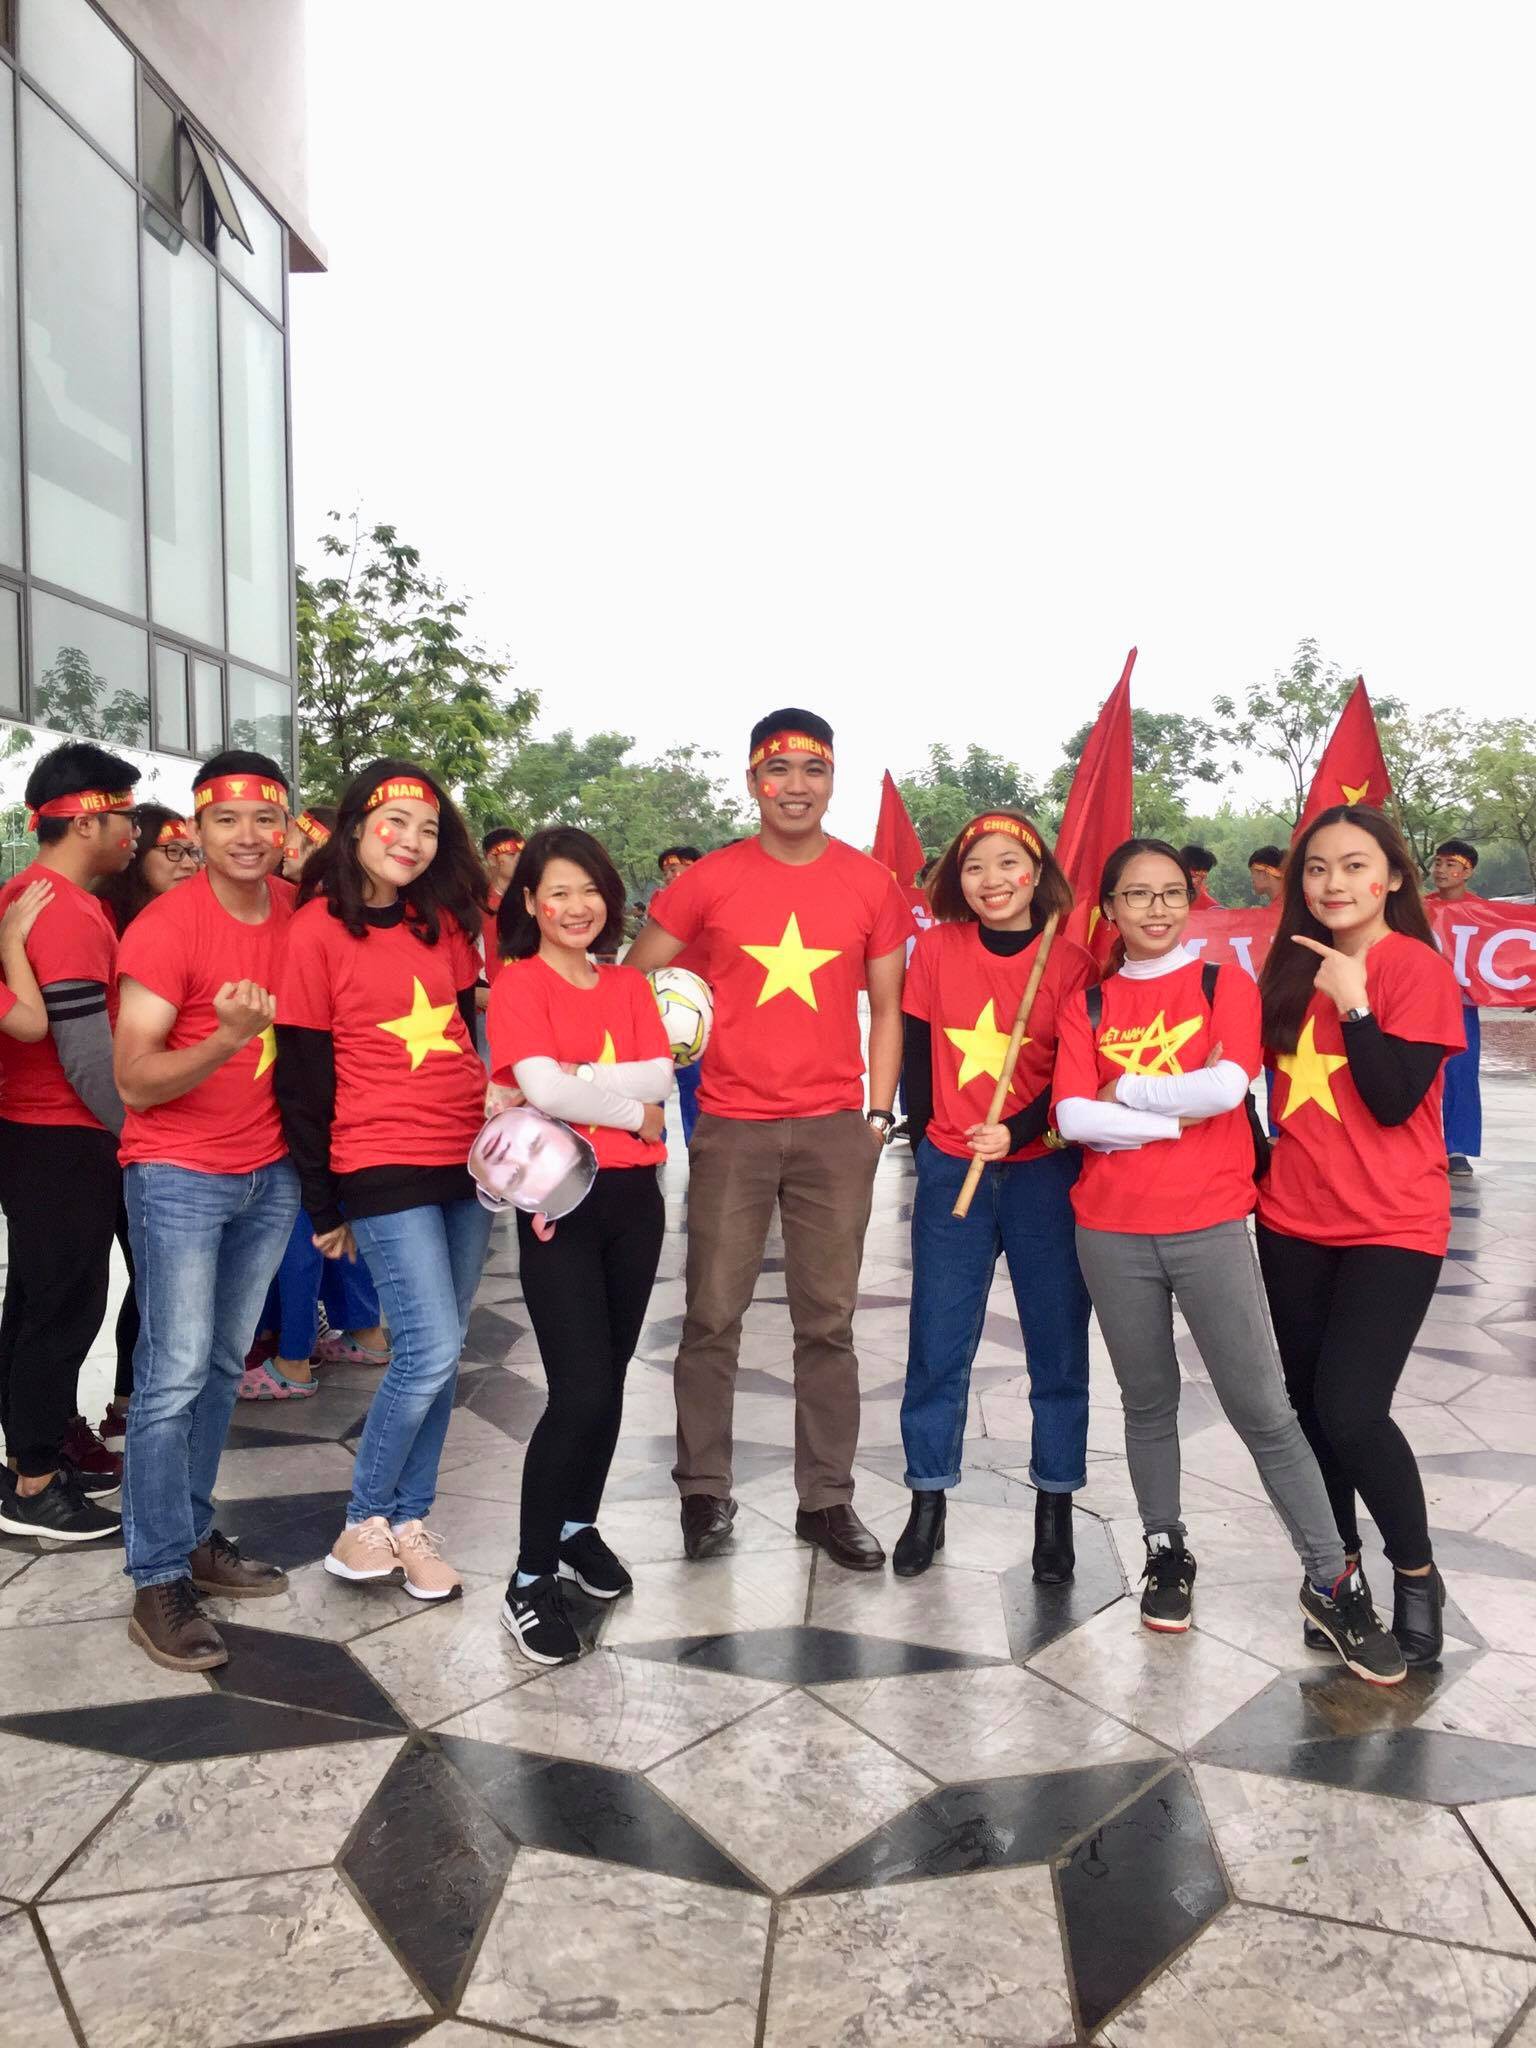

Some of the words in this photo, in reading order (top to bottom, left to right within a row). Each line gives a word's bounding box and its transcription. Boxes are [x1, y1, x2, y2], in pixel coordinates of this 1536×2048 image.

[788, 735, 822, 756] CHIẾN
[388, 783, 425, 799] NAM
[79, 795, 106, 811] VIỆT
[982, 820, 1019, 836] CHIẾN
[1120, 1027, 1147, 1042] NAM
